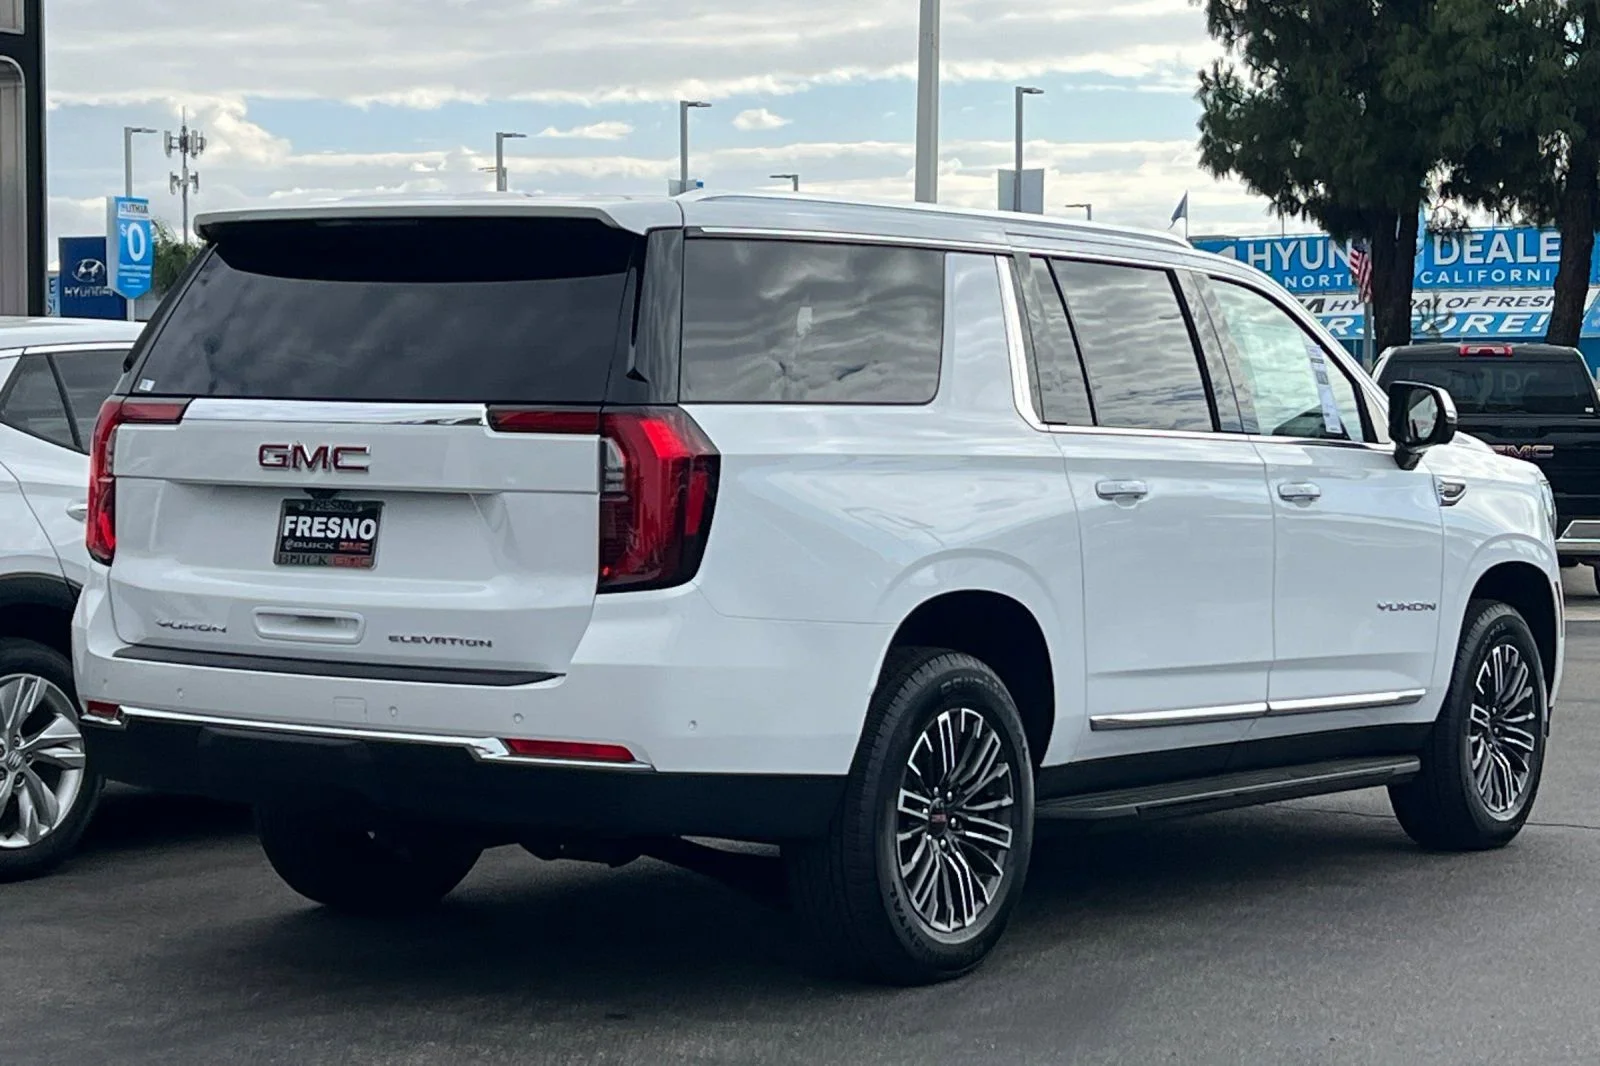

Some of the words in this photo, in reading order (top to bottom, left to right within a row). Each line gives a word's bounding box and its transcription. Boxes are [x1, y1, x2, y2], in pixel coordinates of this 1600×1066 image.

[1247, 238, 1353, 271] HYUN
[1433, 231, 1561, 265] DEALE
[1285, 273, 1353, 288] NORT
[1420, 268, 1550, 284] CALIFORNI
[1445, 297, 1481, 308] OF
[258, 443, 371, 472] GMC
[283, 515, 377, 540] FRESNO
[293, 541, 335, 550] BUICK
[1376, 602, 1437, 612] YUKON
[155, 617, 228, 634] YUKON
[387, 633, 494, 649] ELEVATION
